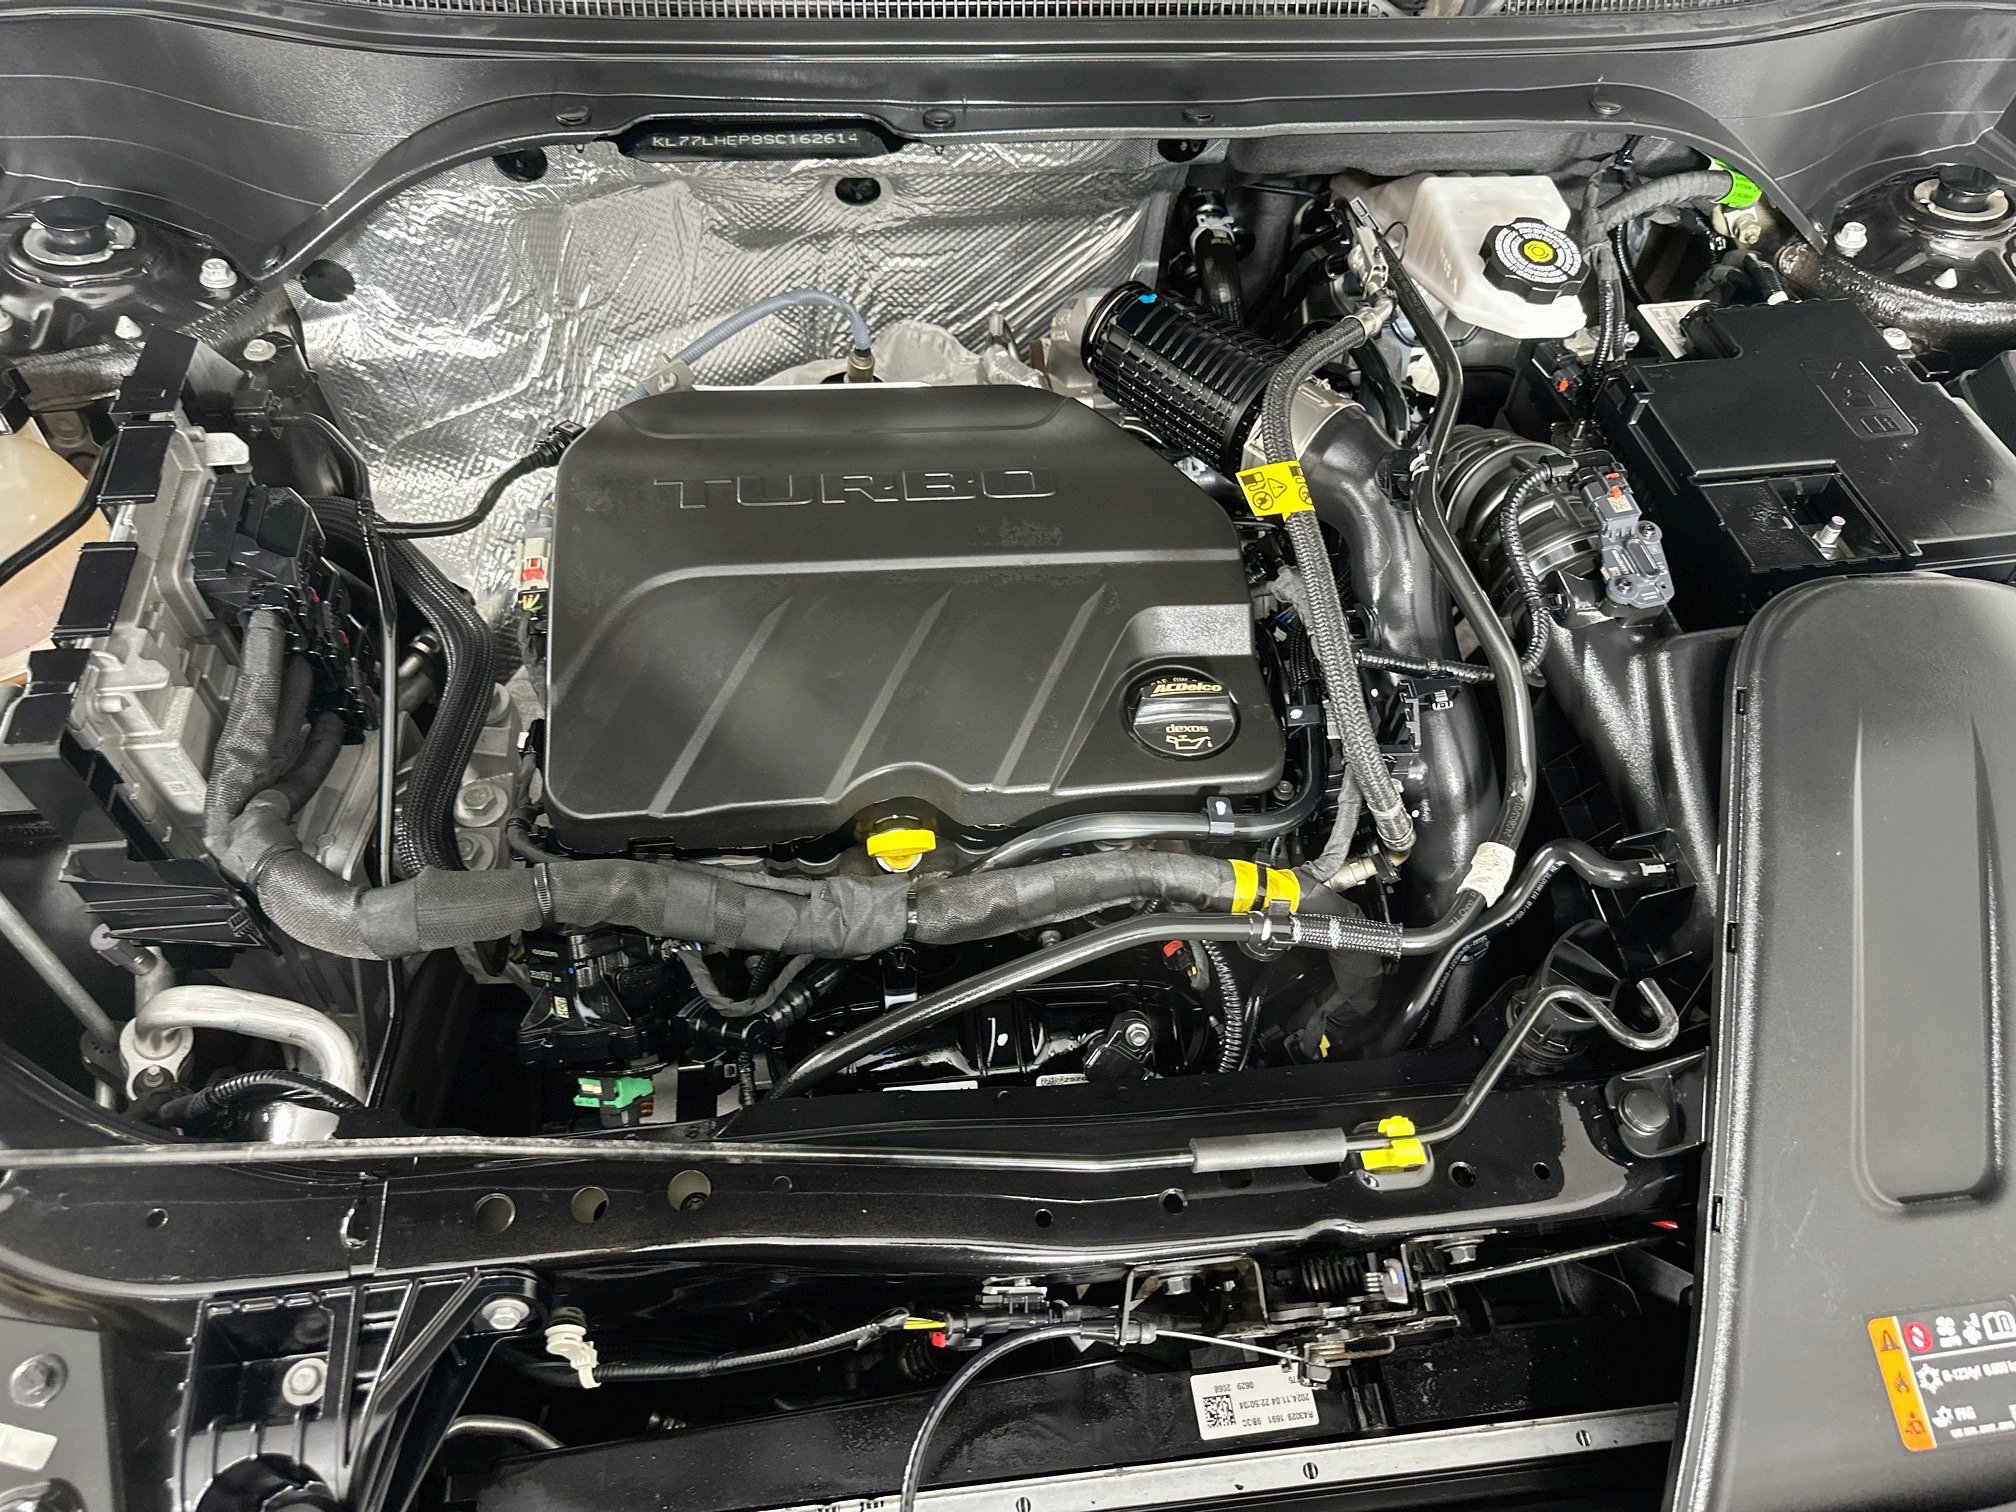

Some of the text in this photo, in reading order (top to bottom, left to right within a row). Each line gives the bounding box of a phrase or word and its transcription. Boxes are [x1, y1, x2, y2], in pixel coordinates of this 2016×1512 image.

[652, 132, 859, 148] KL77LHEP8SC162614
[653, 467, 1057, 510] TURBO
[1153, 682, 1223, 694] ACDelco
[1165, 723, 1209, 734] dexos
